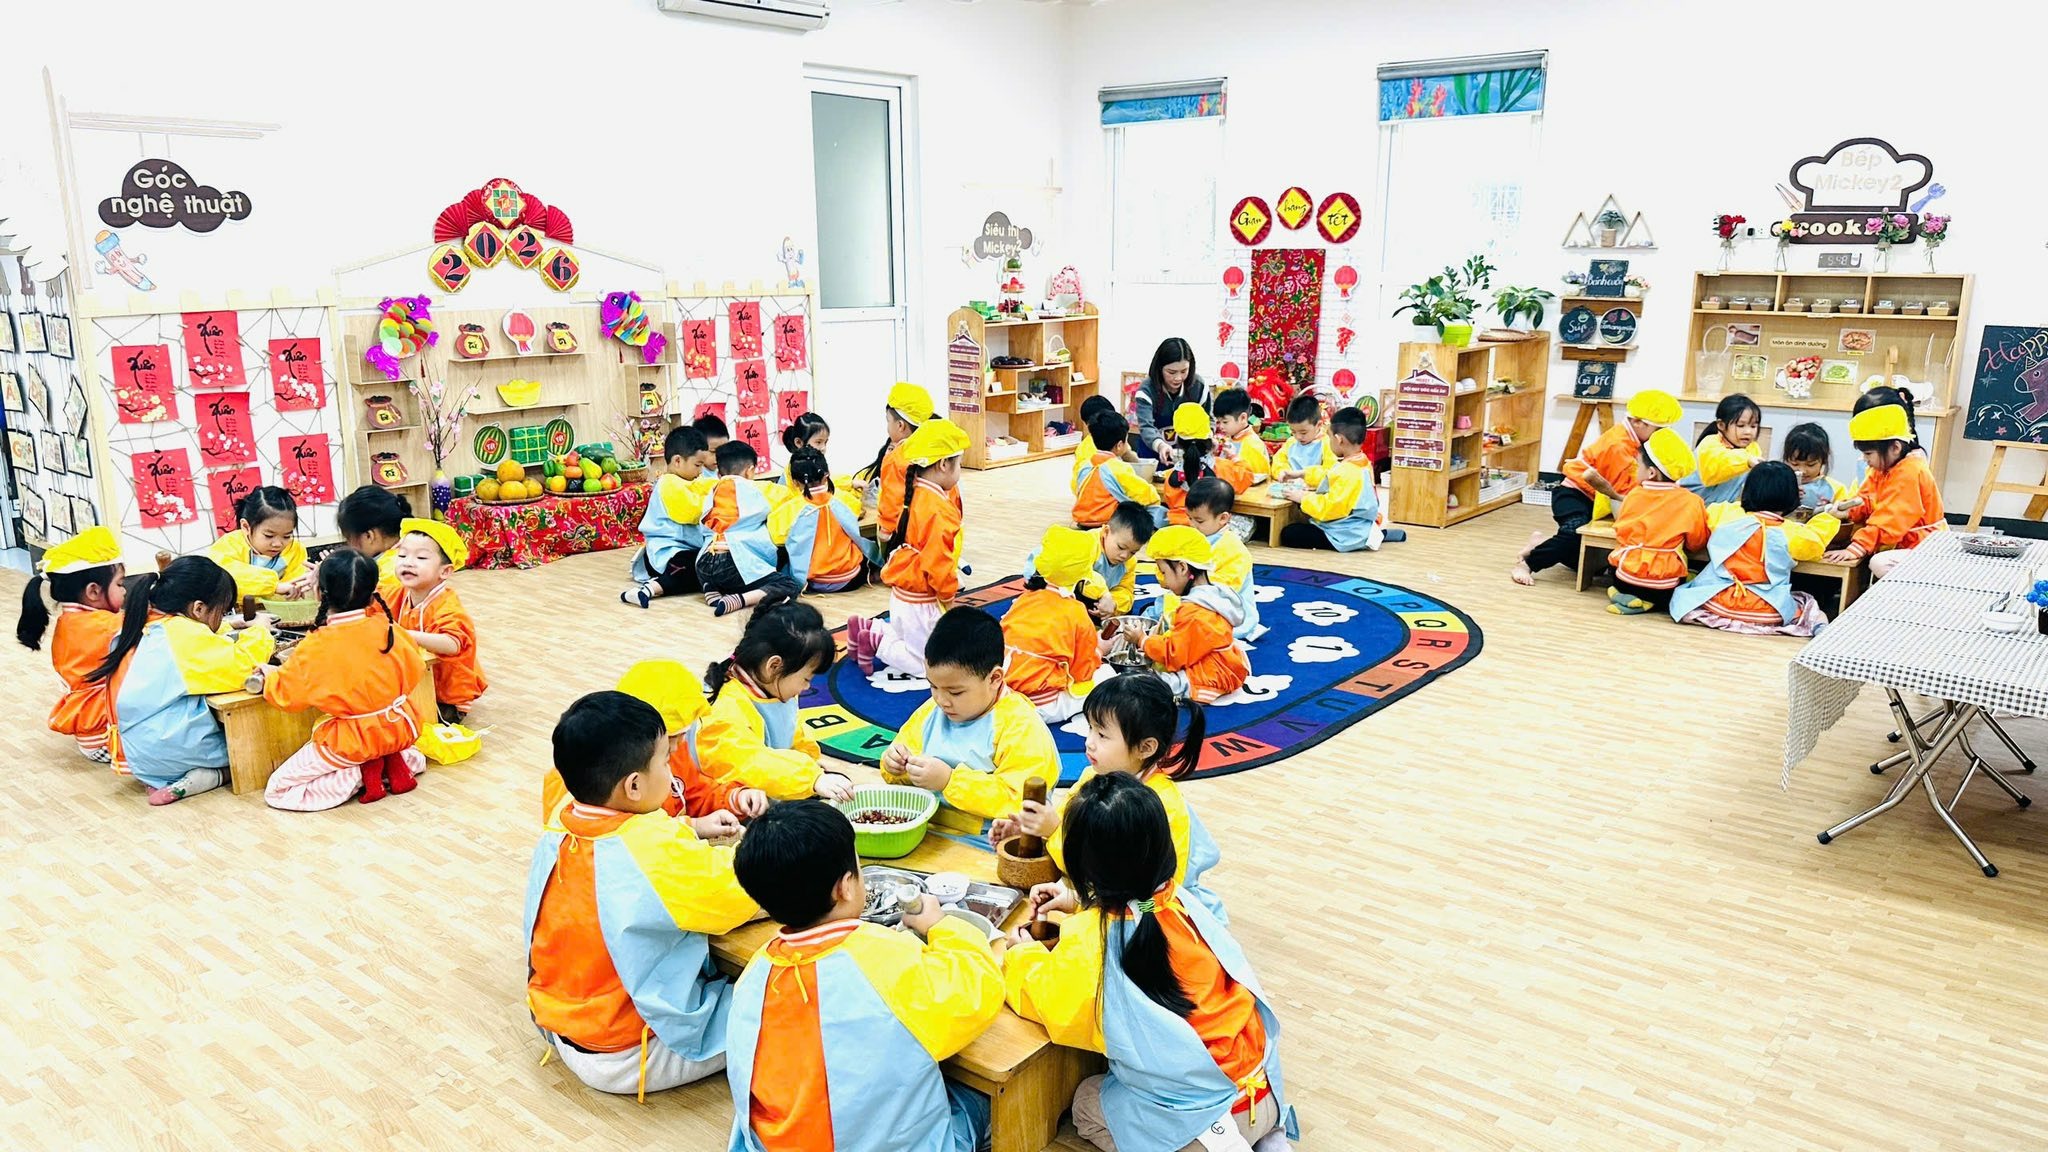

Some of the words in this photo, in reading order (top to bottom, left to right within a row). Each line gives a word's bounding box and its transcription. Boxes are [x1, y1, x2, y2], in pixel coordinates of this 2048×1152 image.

[133, 165, 187, 189] Góc
[111, 192, 175, 218] nghệ
[184, 193, 242, 218] thuật
[985, 222, 1005, 236] Siêu
[1982, 330, 2048, 373] Happ
[1353, 586, 1382, 595] O
[1305, 607, 1342, 619] 10
[1397, 602, 1424, 611] P
[1414, 619, 1447, 628] Q
[1418, 638, 1452, 649] R
[1392, 659, 1430, 670] S
[1356, 681, 1393, 692] T
[1315, 699, 1357, 712] U
[806, 714, 848, 729] B
[1278, 720, 1320, 733] V
[860, 733, 892, 750] A
